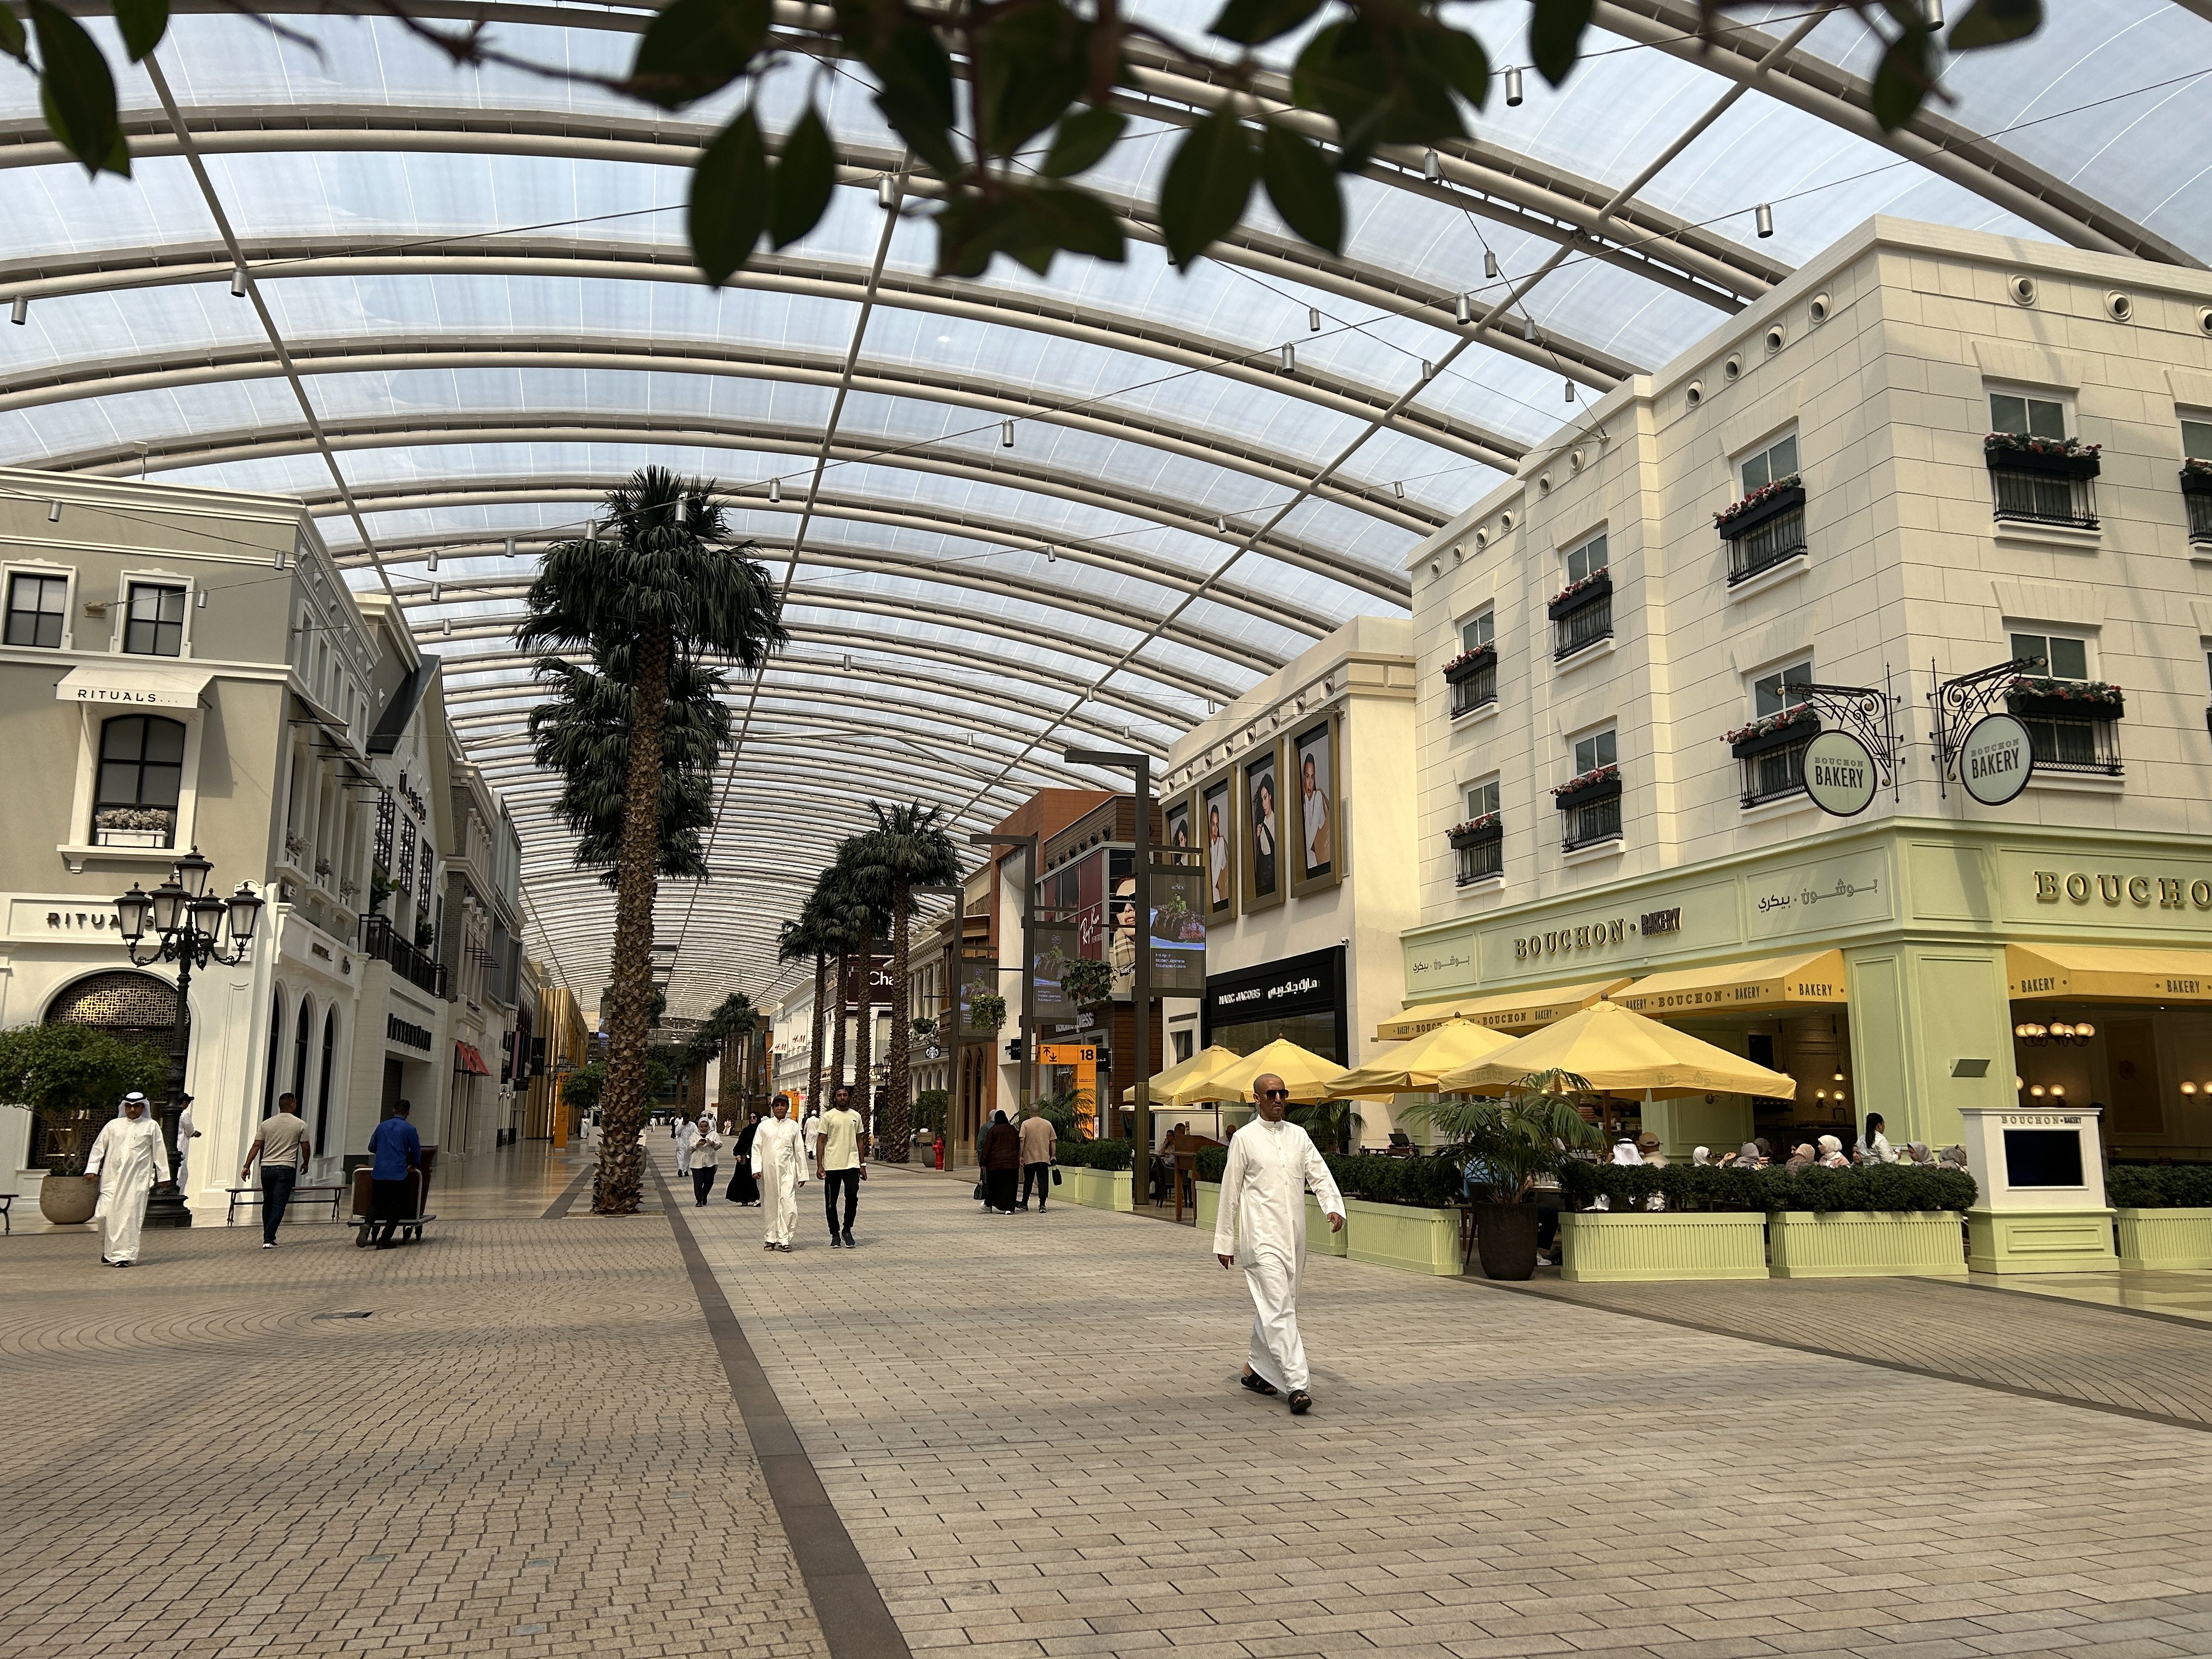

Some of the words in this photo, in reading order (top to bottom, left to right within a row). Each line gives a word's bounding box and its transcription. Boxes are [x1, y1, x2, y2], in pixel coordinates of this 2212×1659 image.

[1971, 738, 2020, 757] BOUCHON
[1814, 757, 1864, 767] BOUCHON
[1972, 747, 2020, 779] BAKERY
[1815, 765, 1864, 789] BAKERY
[1801, 878, 1878, 905] بوشون
[2034, 871, 2212, 906] BOUCHO
[1758, 895, 1791, 913] بيكري
[46, 912, 154, 927] RITUAS
[1514, 918, 1625, 960] BOUCHON
[1640, 907, 1681, 936] BAKERY
[1799, 983, 1832, 997] BAKERY
[2021, 977, 2055, 992] BAKERY
[2167, 980, 2200, 994] BAKERY
[1218, 993, 1235, 1005] MARC
[1235, 988, 1261, 1002] JACOBS
[1626, 998, 1646, 1010] BAKERY
[1658, 991, 1722, 1007] BOUCHON
[1735, 986, 1760, 1000] BAKERY
[1483, 1012, 1527, 1026] BOUCHON
[1535, 1009, 1553, 1021] BAKERY
[792, 1035, 805, 1043] H&M
[1080, 1049, 1094, 1060] 18
[2001, 1115, 2059, 1124] BOUCHON
